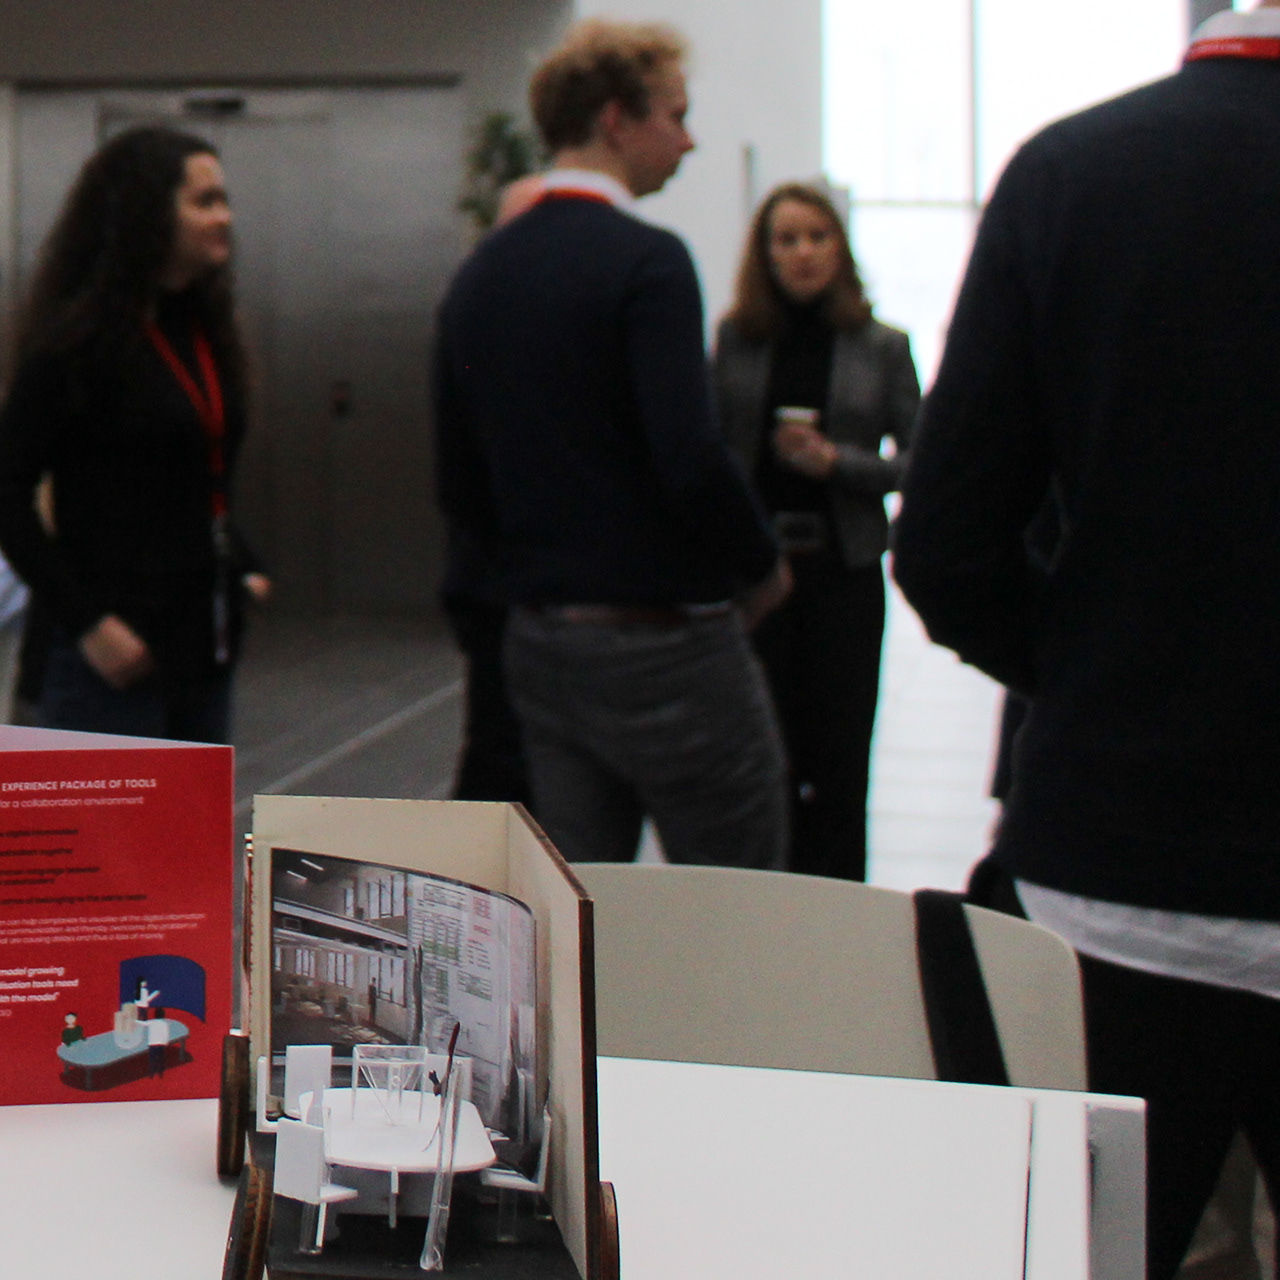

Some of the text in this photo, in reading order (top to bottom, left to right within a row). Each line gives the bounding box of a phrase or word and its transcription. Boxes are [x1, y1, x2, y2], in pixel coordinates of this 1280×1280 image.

[2, 780, 58, 792] EXPERIENCE
[60, 780, 106, 790] PACKAGE
[108, 779, 122, 788] OF
[124, 778, 156, 788] TOOLS
[20, 798, 82, 808] collaboration
[84, 796, 144, 806] environment
[27, 966, 65, 978] growing
[32, 980, 54, 988] tools
[55, 979, 79, 987] need
[11, 994, 26, 1002] the
